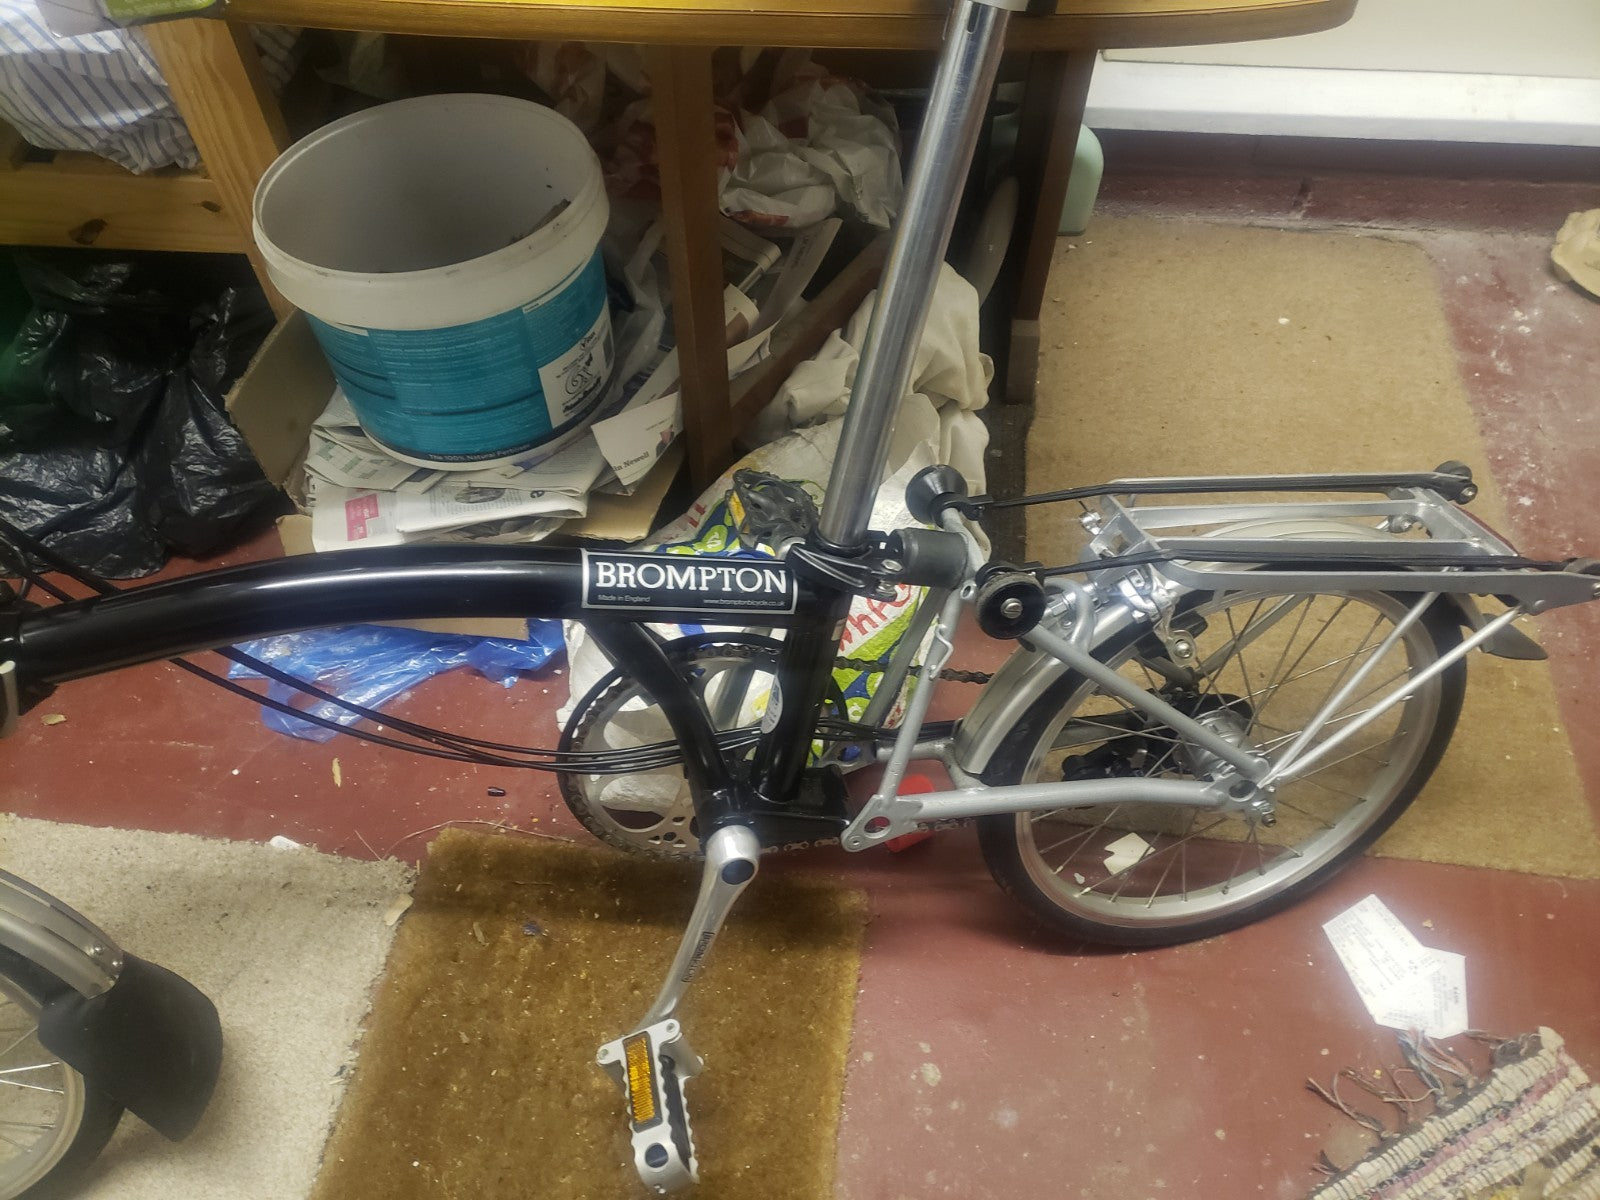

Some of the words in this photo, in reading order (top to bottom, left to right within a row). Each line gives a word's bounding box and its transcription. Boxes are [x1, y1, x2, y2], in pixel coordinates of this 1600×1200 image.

[623, 451, 650, 468] Newell
[596, 561, 786, 593] BROMPTON
[598, 594, 616, 602] Made
[626, 595, 651, 603] England
